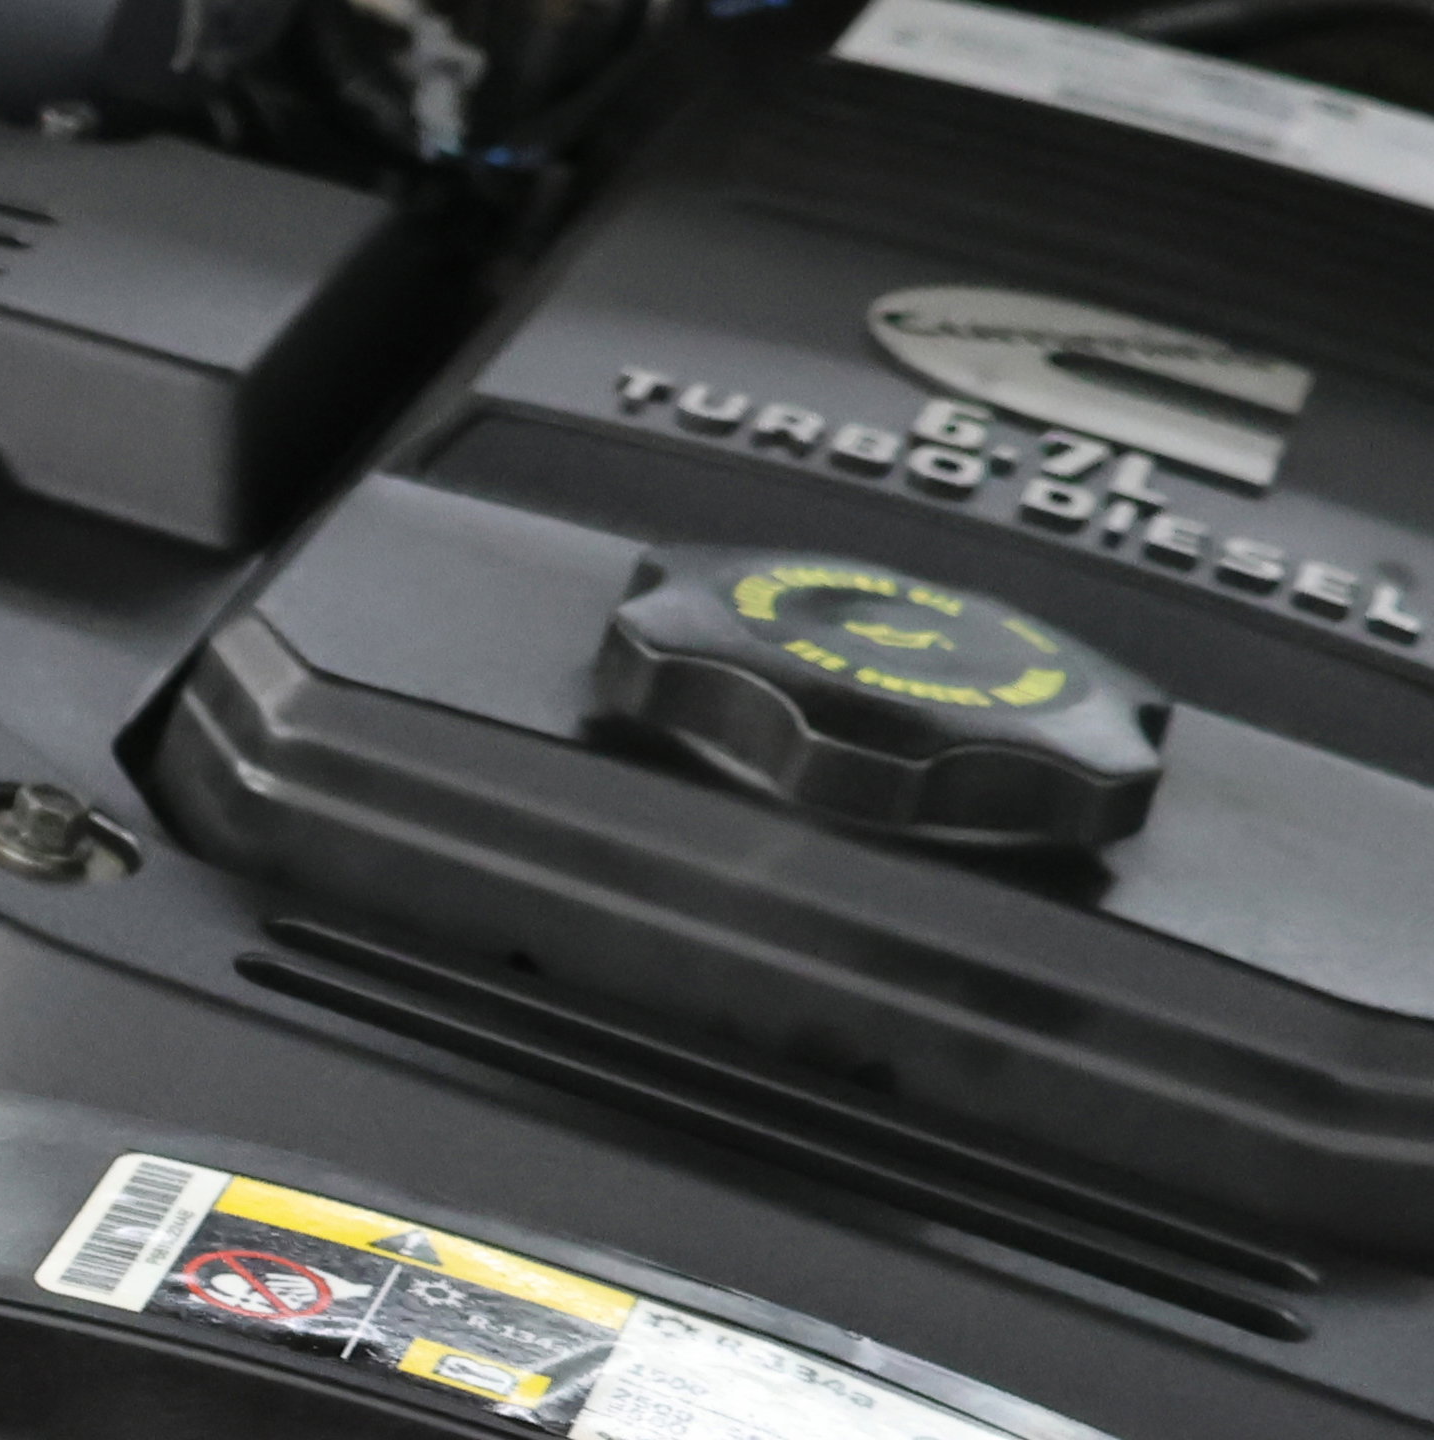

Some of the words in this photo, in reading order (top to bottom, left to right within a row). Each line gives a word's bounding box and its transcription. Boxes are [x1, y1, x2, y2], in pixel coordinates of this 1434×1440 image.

[614, 364, 992, 500] TURBO
[1017, 476, 1428, 646] DIESEL
[911, 396, 1169, 510] 6.7L
